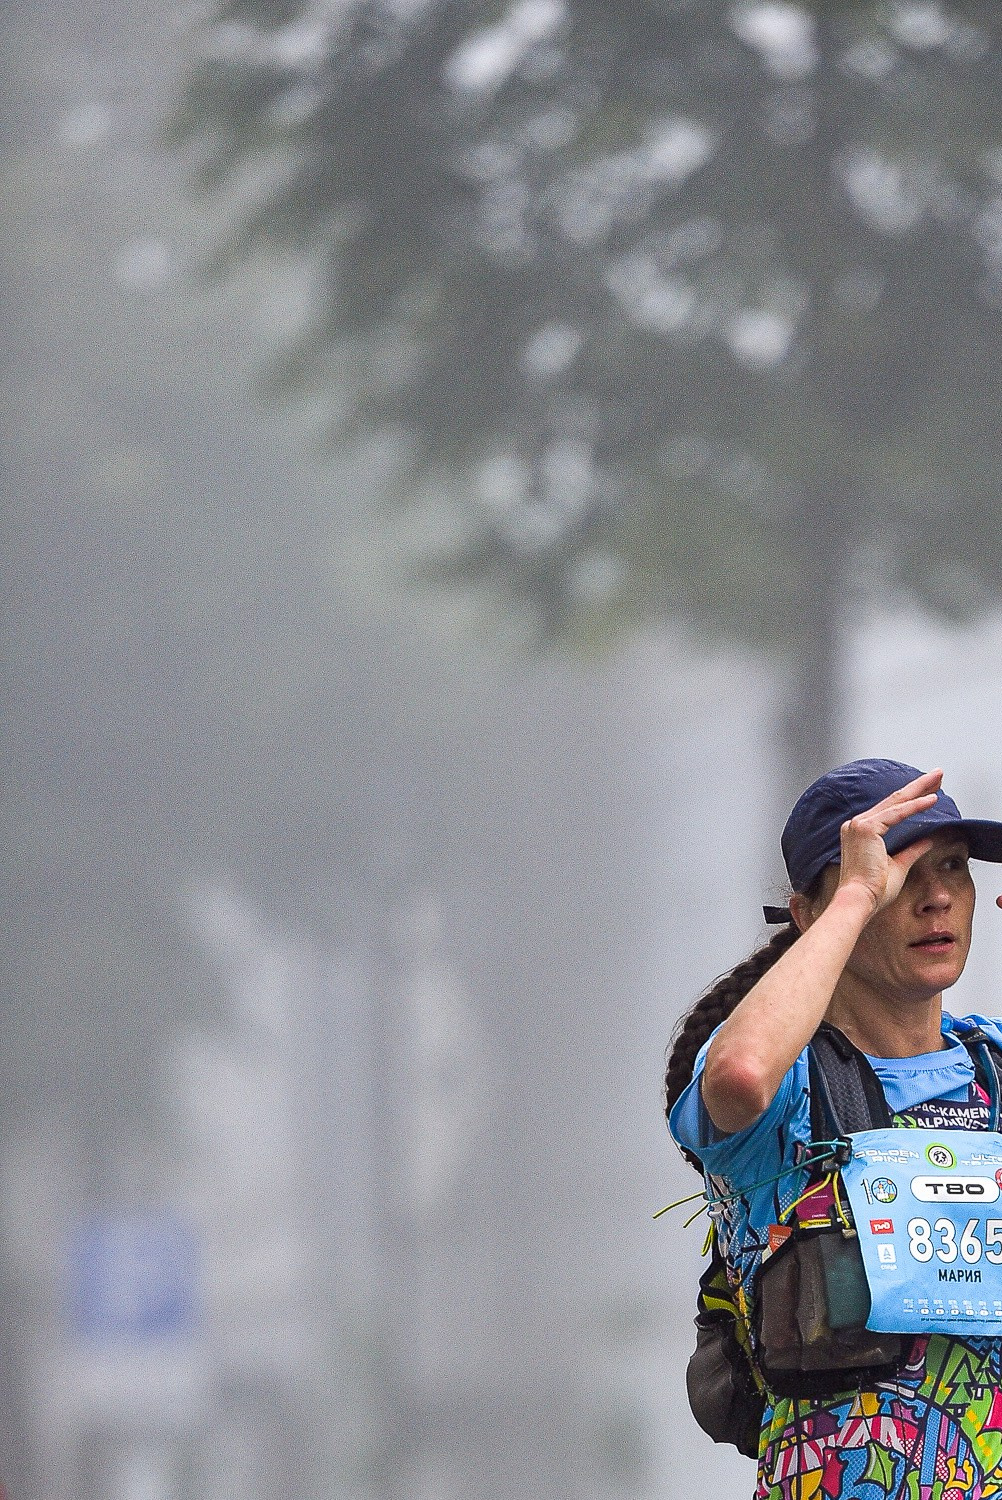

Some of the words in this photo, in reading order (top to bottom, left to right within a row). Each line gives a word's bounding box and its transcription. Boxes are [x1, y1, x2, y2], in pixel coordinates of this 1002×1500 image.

[854, 1149, 920, 1159] GOLDEN
[872, 1155, 908, 1164] RING
[938, 1269, 982, 1283] МАРИЯ
